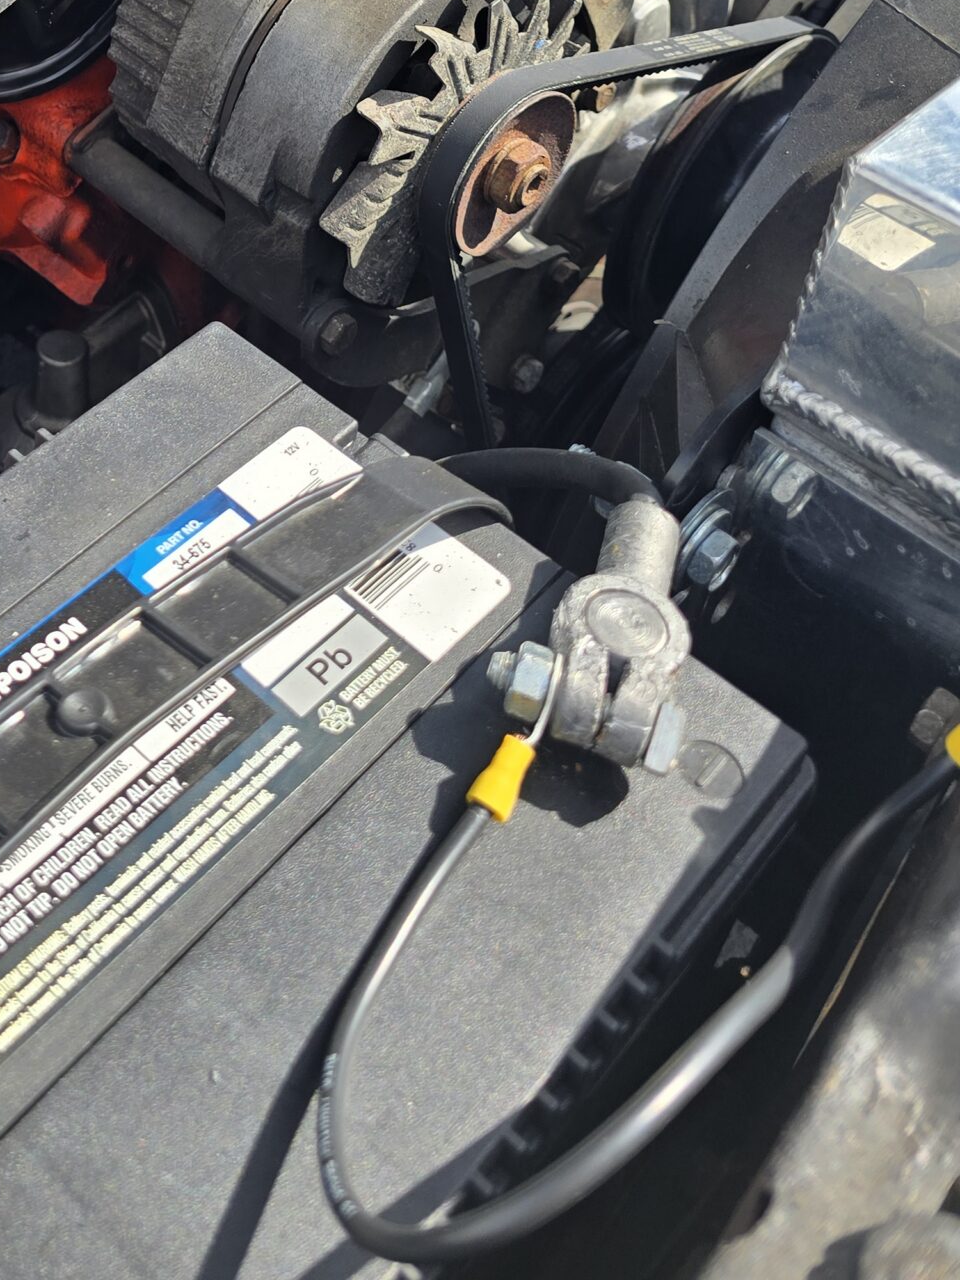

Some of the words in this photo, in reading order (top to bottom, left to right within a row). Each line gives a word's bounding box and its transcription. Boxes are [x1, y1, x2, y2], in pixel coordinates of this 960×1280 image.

[283, 441, 301, 458] 12V
[155, 529, 187, 556] PART
[181, 516, 203, 535] NO.
[171, 537, 212, 571] 34-675
[304, 641, 355, 686] Pb
[337, 666, 379, 703] BATTERY
[351, 692, 371, 710] BE
[362, 657, 410, 698] RECYCLED.
[165, 703, 198, 732] HELP
[194, 678, 228, 708] FAST.
[11, 877, 40, 903] OF
[28, 823, 102, 887] CHILDREN.
[90, 794, 133, 832] READ
[123, 774, 156, 804] ALL
[144, 707, 234, 785] INSTRUCTIONS.
[53, 787, 96, 825] SEVERE
[91, 755, 133, 792] BURNS.
[0, 826, 51, 871] SMOKING
[25, 888, 60, 920] TIP.
[49, 870, 80, 898] DO
[68, 846, 108, 881] NOT
[95, 819, 137, 857] OPEN
[125, 772, 191, 830] BATTERY.
